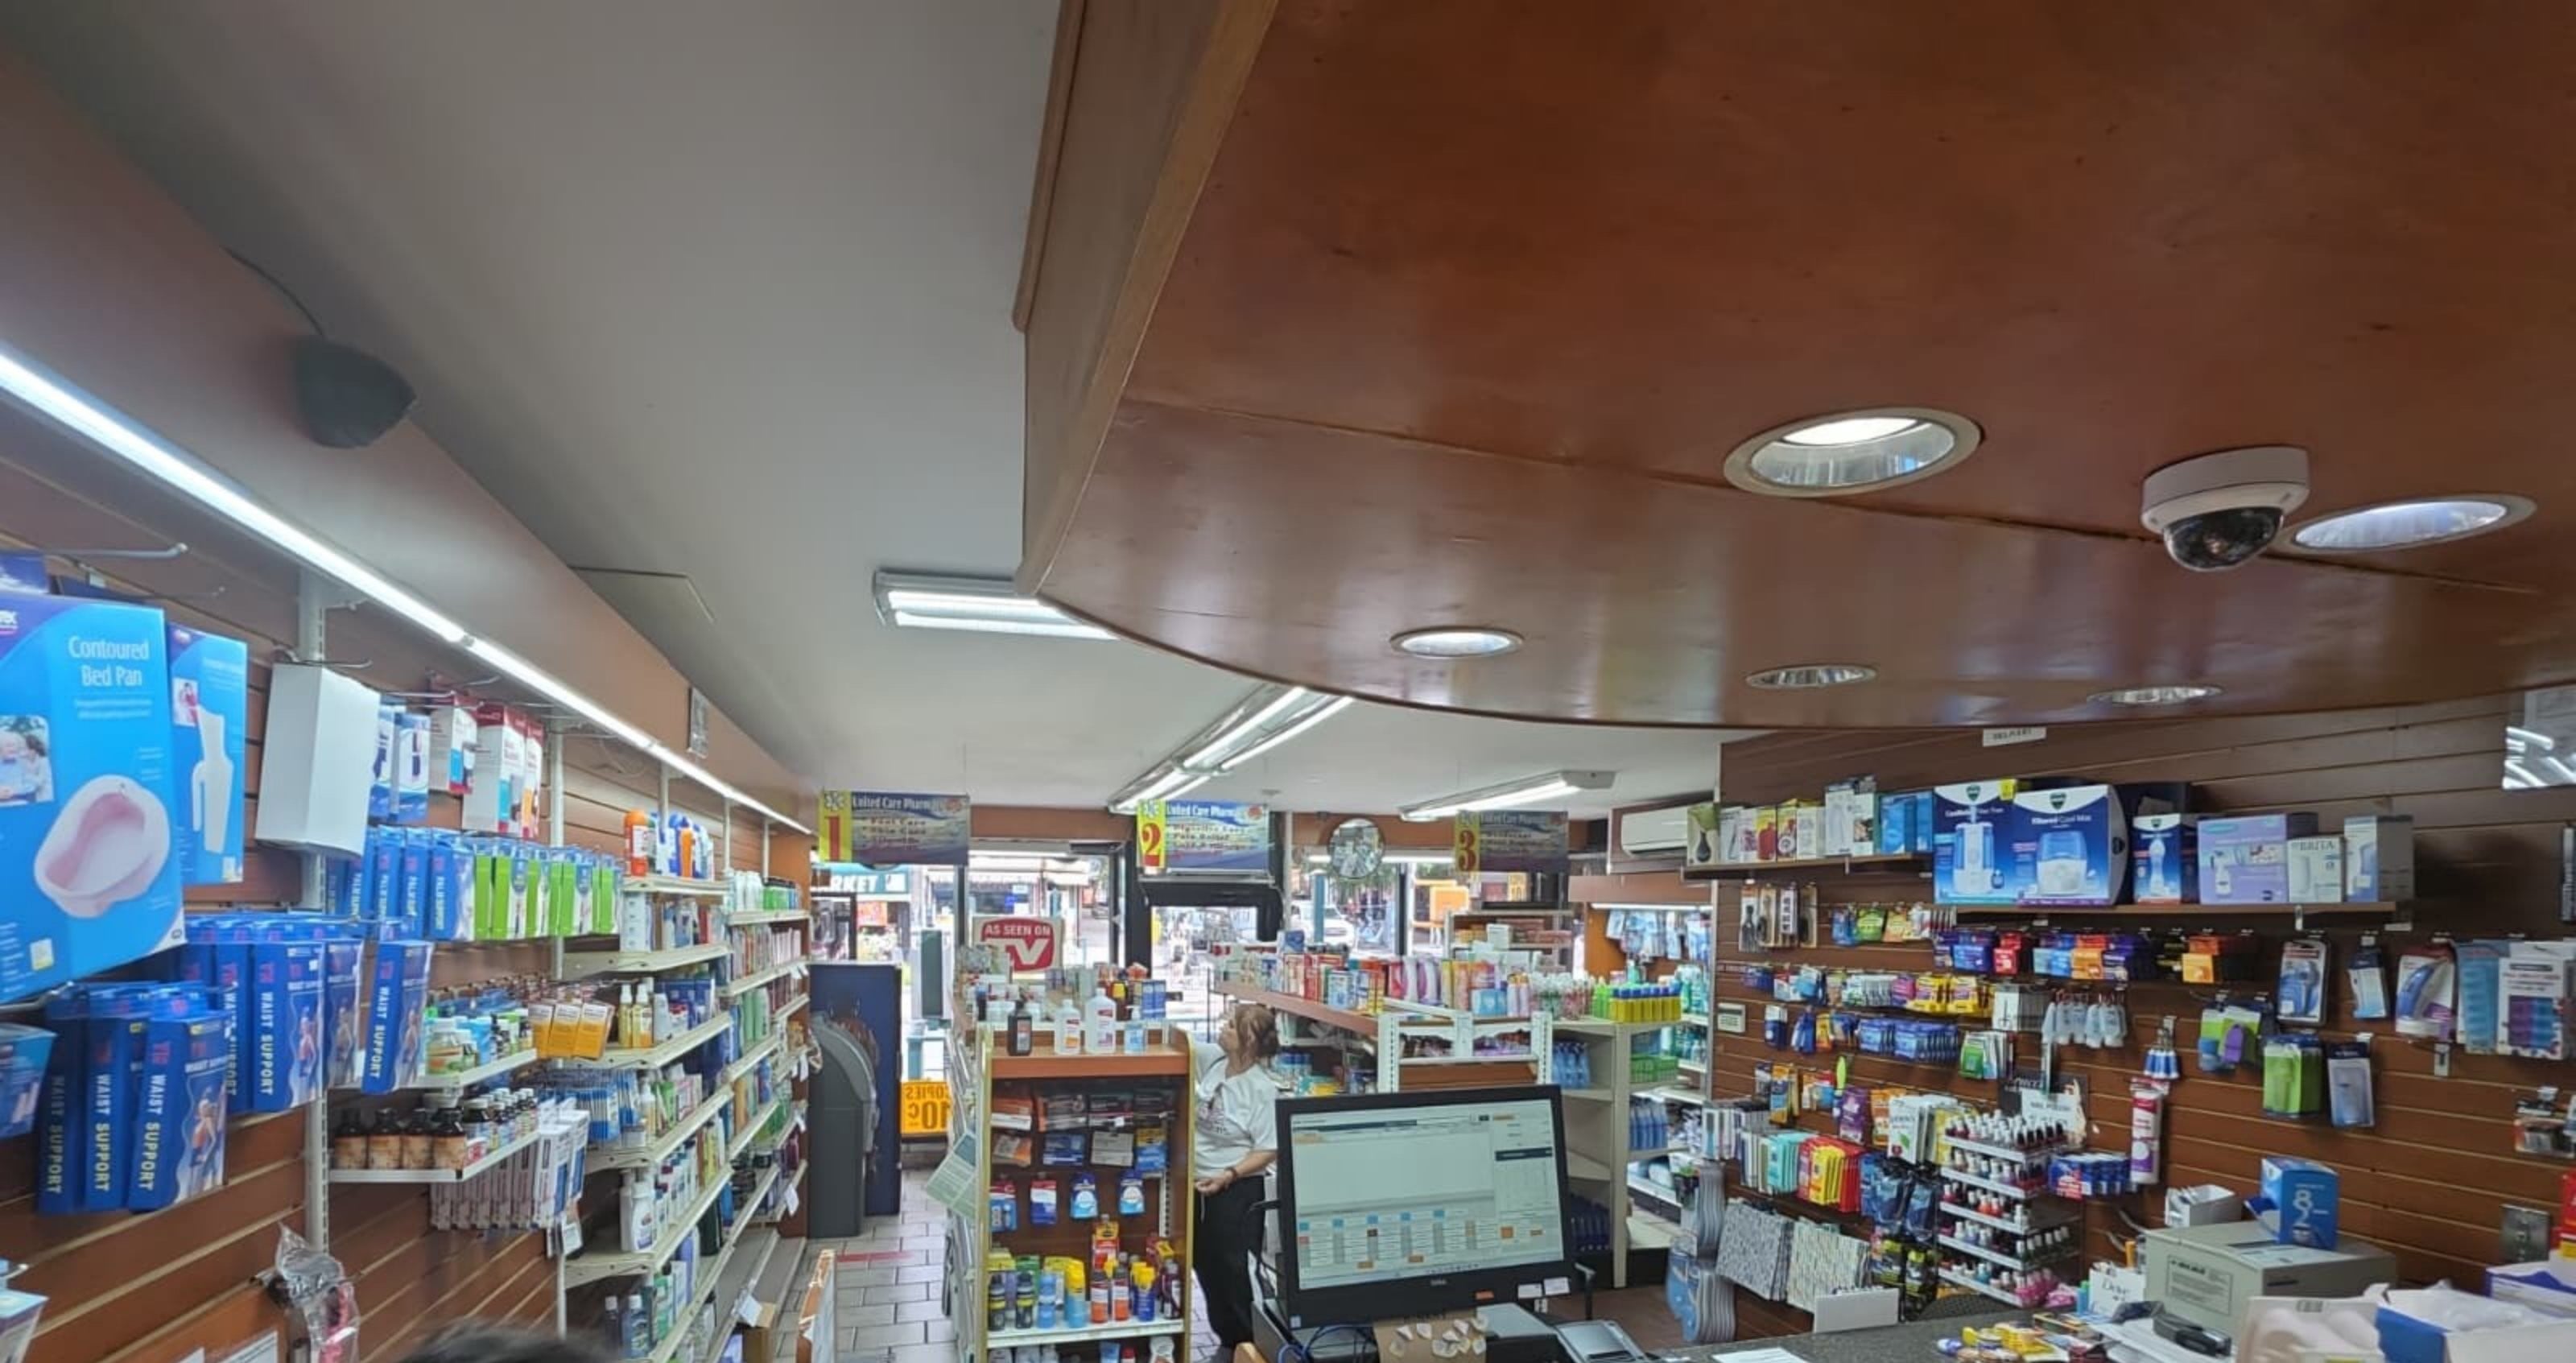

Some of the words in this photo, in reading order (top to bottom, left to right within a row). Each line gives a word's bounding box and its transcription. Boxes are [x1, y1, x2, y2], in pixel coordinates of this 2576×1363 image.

[68, 635, 151, 659] Contoured
[81, 664, 111, 686] Bed
[116, 665, 142, 686] Pan
[852, 797, 881, 809] United
[882, 798, 902, 809] Care
[1141, 822, 1161, 866] 2
[1459, 829, 1476, 872] 3
[831, 874, 879, 892] RKET
[985, 924, 1001, 936] AS
[1003, 924, 1031, 936] SEEN
[1034, 925, 1051, 936] ON
[984, 938, 1051, 966] TV
[261, 991, 274, 1027] WAIST
[376, 986, 390, 1019] WAIST
[260, 1035, 274, 1095] SUPPORT
[369, 1024, 386, 1079] SUPPORT
[96, 1073, 111, 1116] WAIST
[147, 1073, 167, 1116] WAIST
[46, 1126, 64, 1194] SUPPORT
[94, 1122, 110, 1192] SUPPORT
[138, 1121, 160, 1192] SUPPORT
